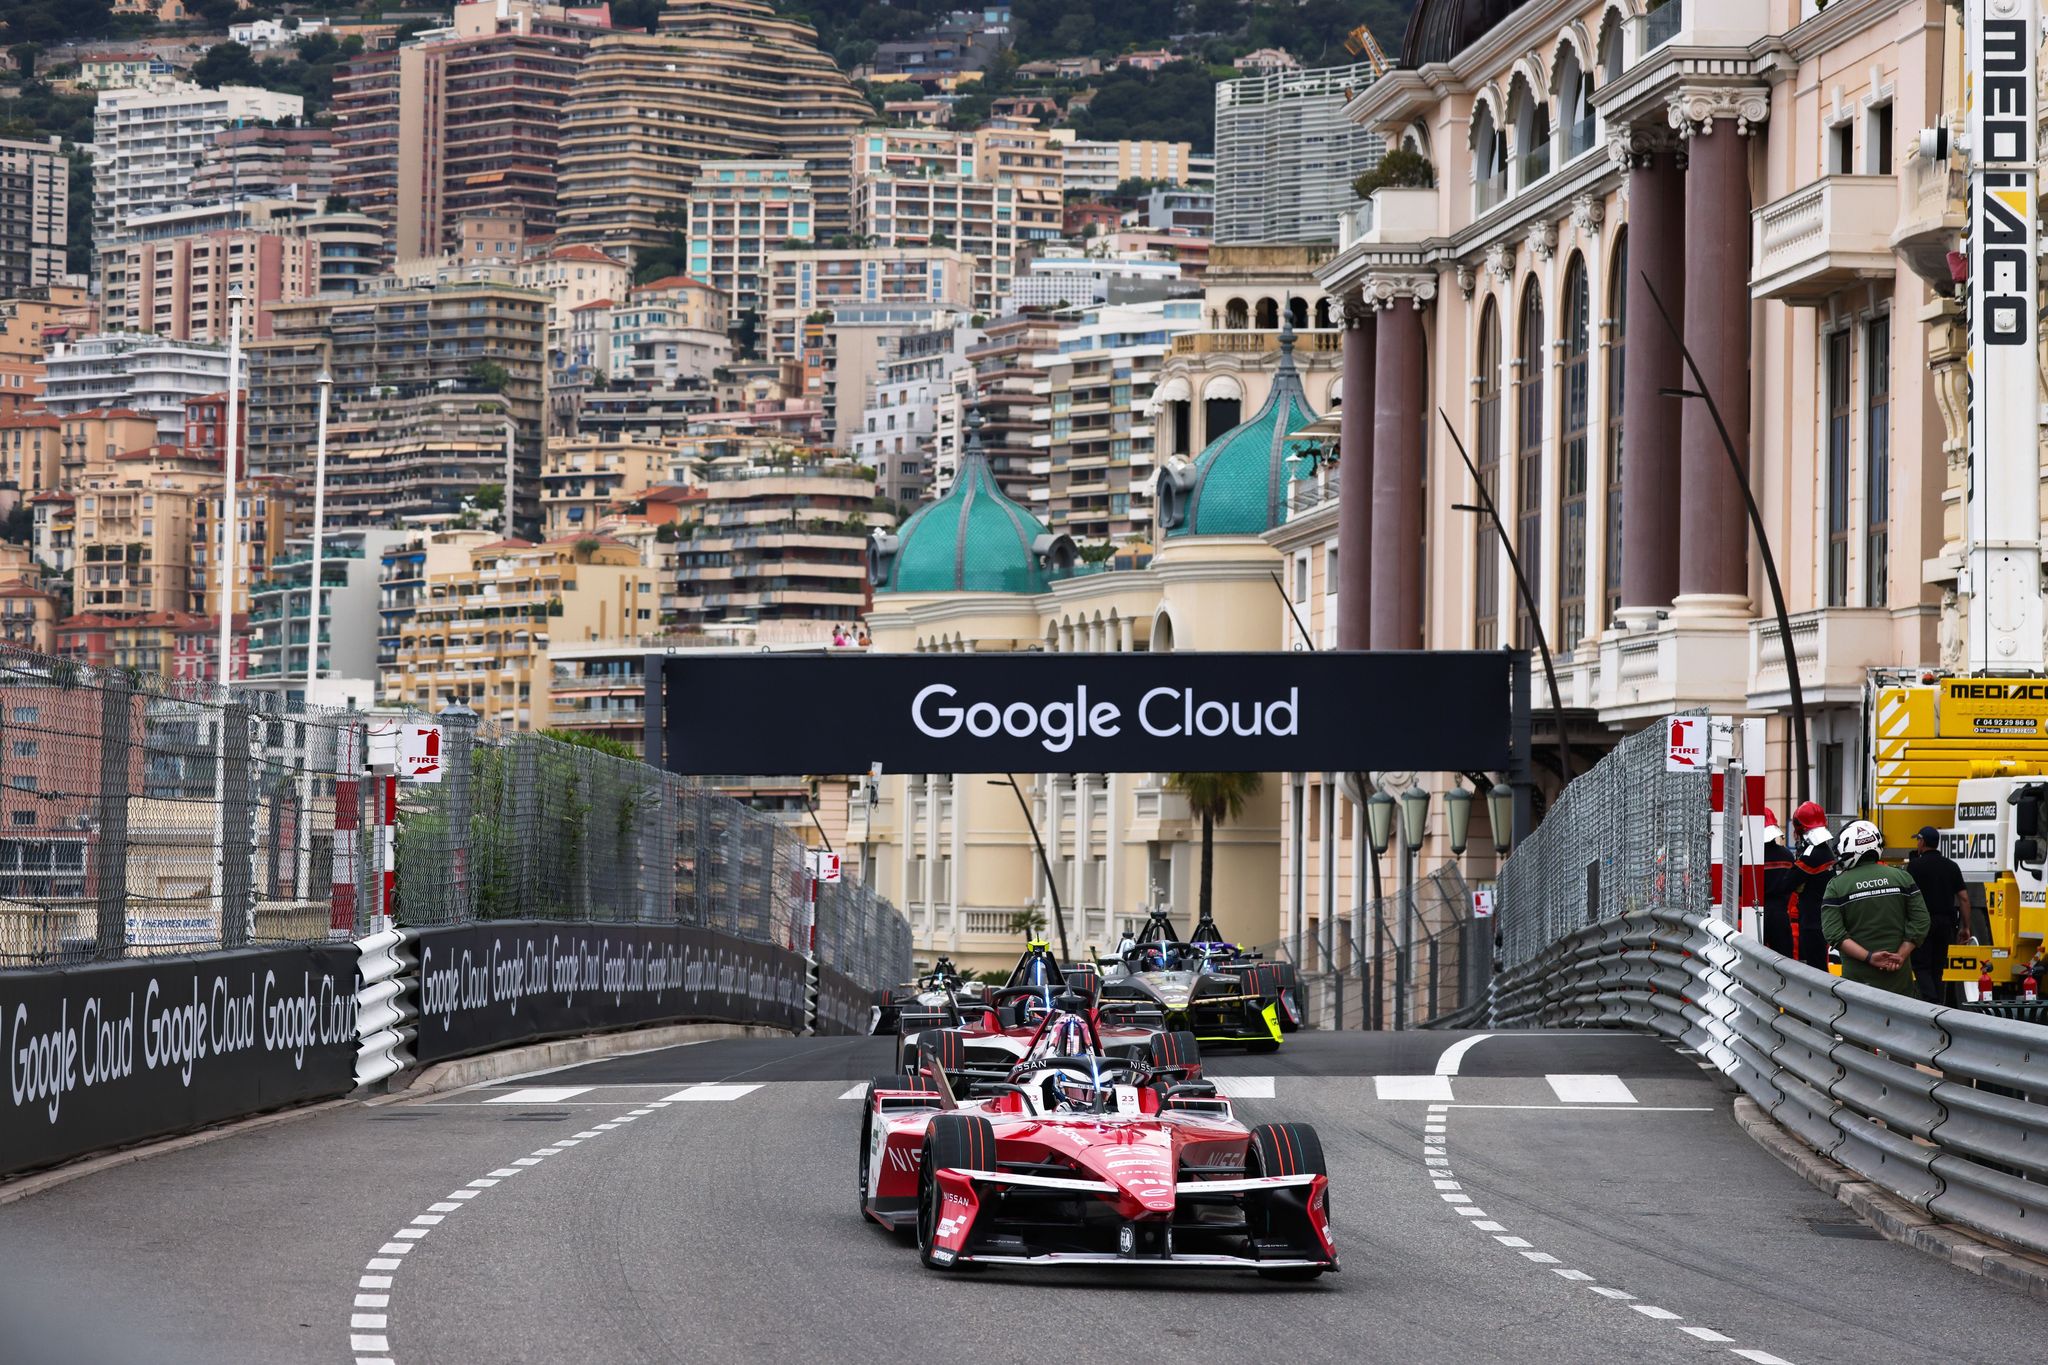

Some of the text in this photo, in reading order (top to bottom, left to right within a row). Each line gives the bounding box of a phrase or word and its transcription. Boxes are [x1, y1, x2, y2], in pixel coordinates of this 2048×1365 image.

[911, 684, 1298, 753] Google Cloud
[1951, 684, 2048, 699] MEDiAC
[409, 756, 439, 764] FIRE
[1969, 806, 1976, 816] DU
[1976, 805, 1996, 816] LEVAGE
[1856, 878, 1889, 889] DOCTOR
[422, 946, 489, 1031] Google Cloud
[493, 938, 549, 1016] Google Cloud
[144, 972, 255, 1087] Google Cloud
[263, 969, 360, 1070] Google Cloud
[11, 991, 134, 1124] Google Cloud
[943, 1191, 970, 1207] NISSAN
